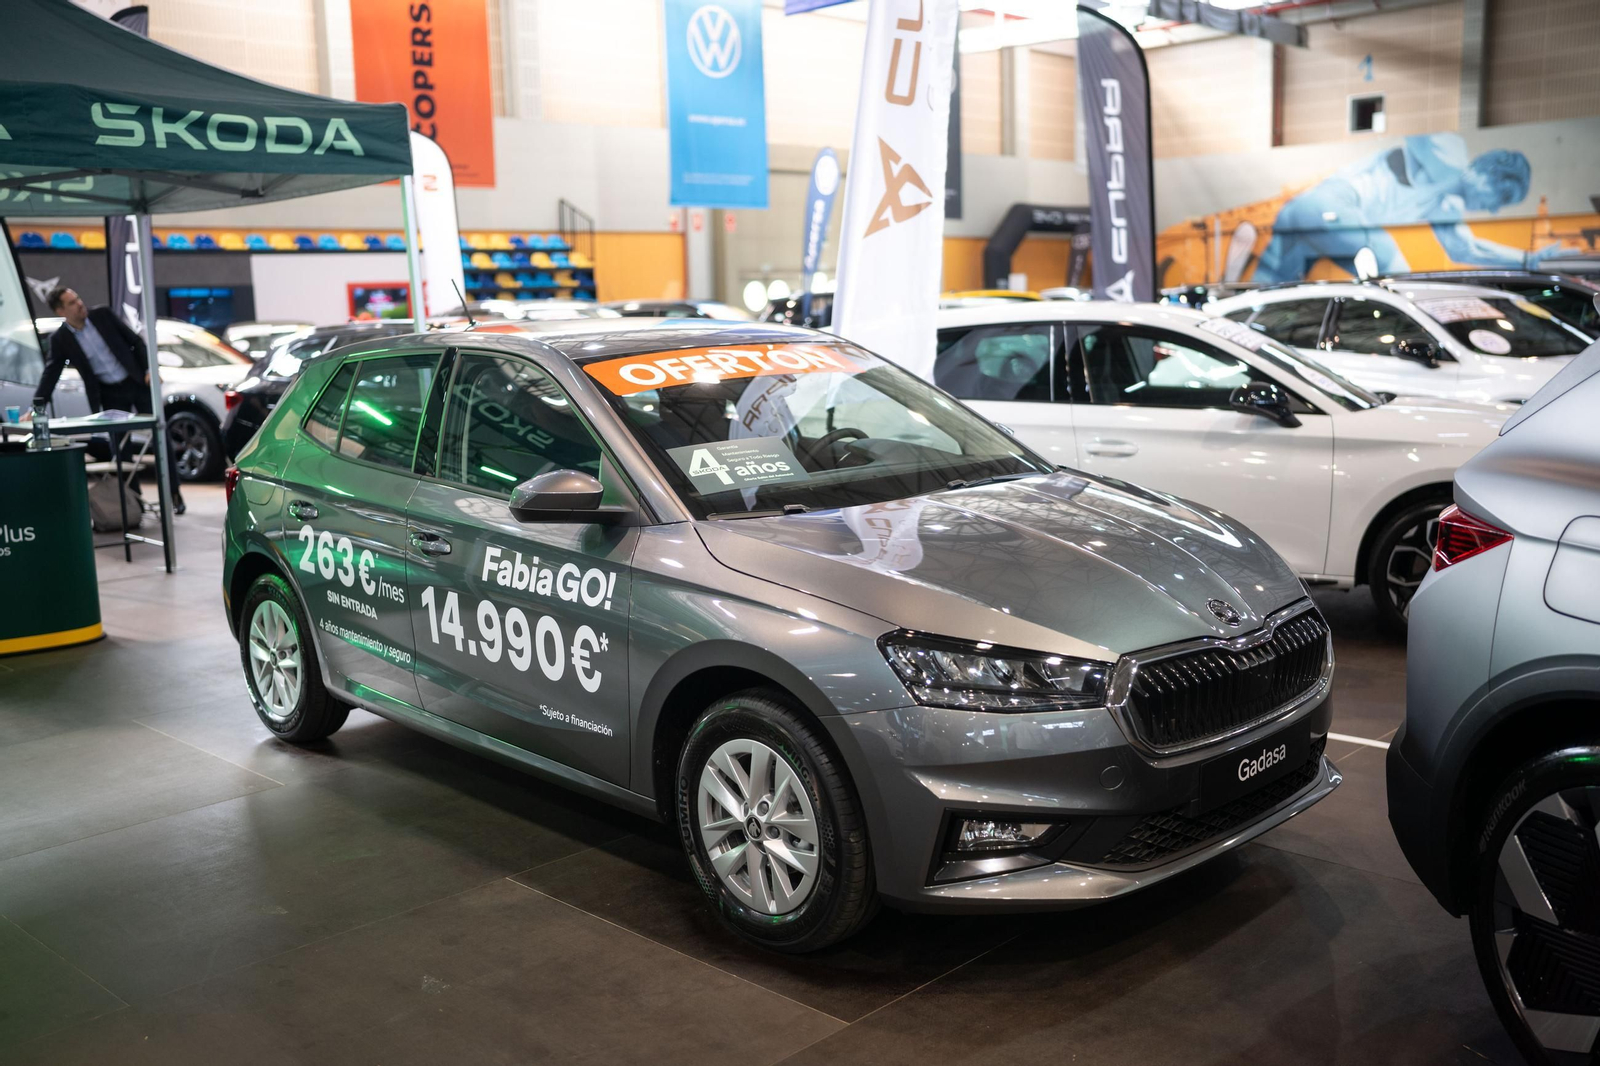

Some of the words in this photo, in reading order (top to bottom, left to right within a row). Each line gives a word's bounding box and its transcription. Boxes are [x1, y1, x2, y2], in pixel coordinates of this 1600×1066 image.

[688, 448, 735, 486] 4
[734, 460, 791, 477] años
[0, 524, 36, 544] lus
[326, 589, 341, 605] SIN
[341, 594, 379, 621] ENTRADA
[319, 617, 325, 629] 4
[324, 619, 339, 635] años
[339, 625, 383, 653] mantenimiento
[383, 644, 389, 658] y
[388, 646, 411, 664] seguro
[564, 714, 570, 723] a
[570, 713, 613, 738] financiación
[1237, 743, 1287, 782] Gadasa
[678, 775, 696, 856] KUMHO
